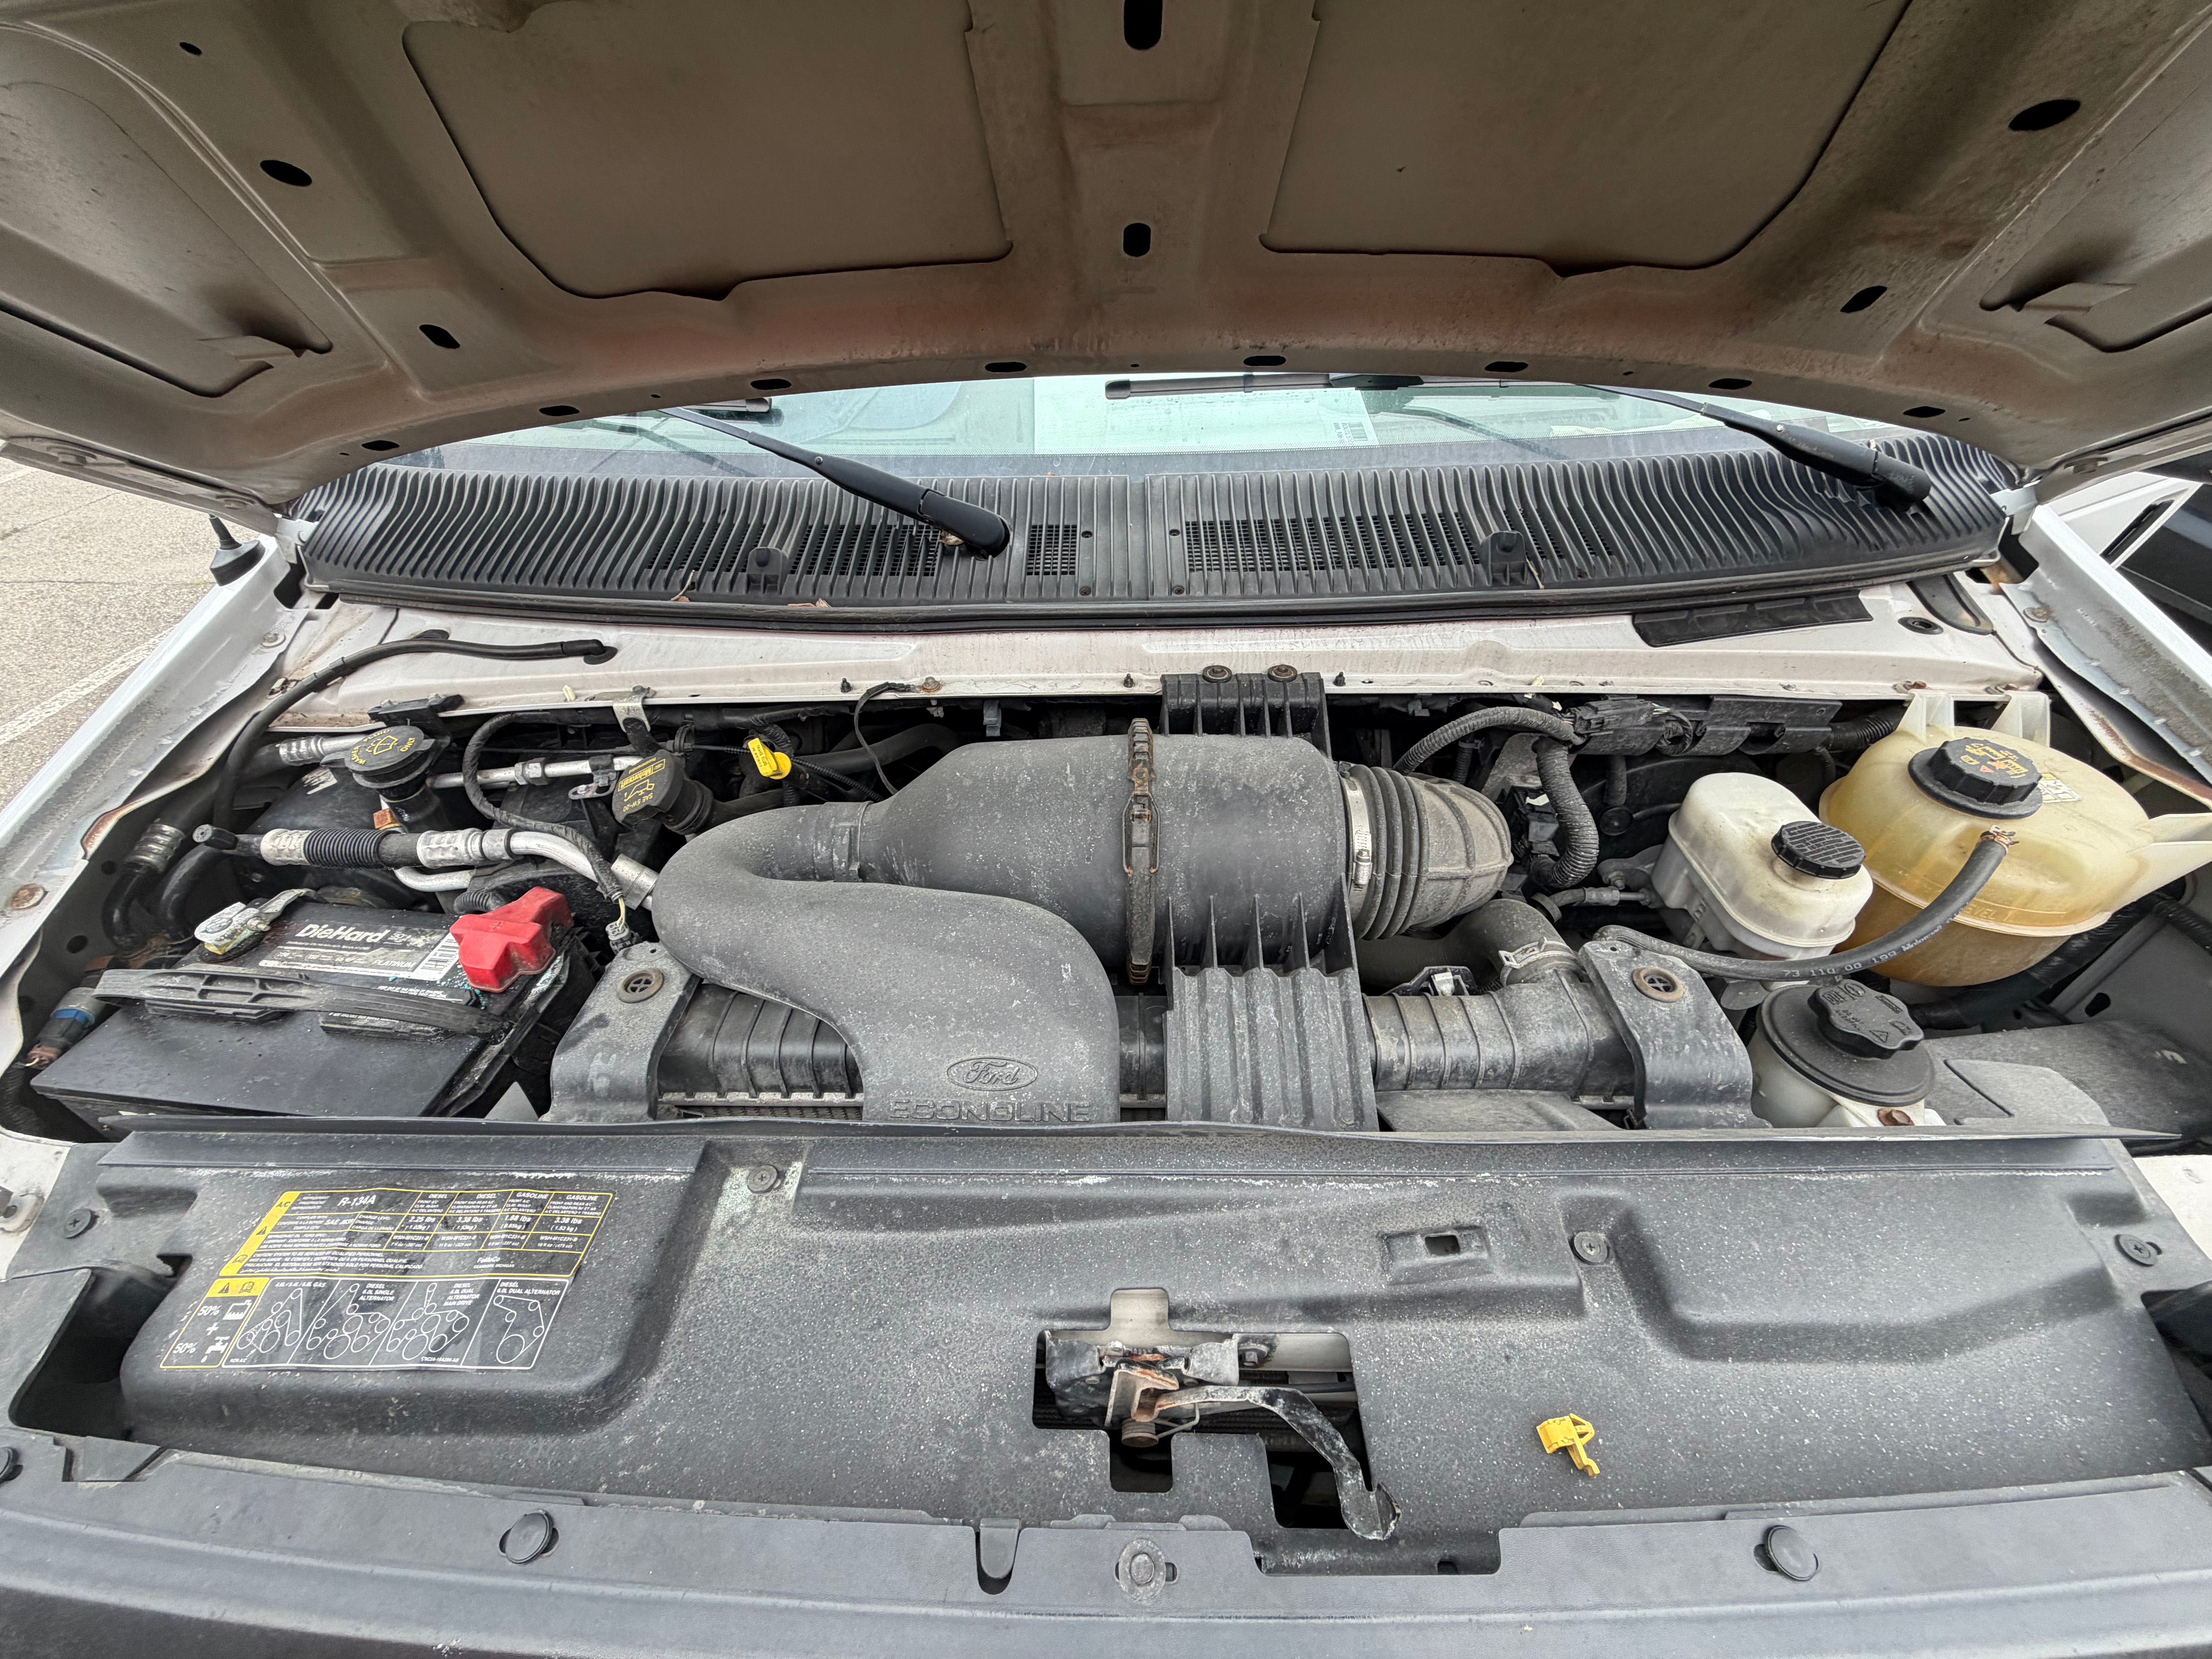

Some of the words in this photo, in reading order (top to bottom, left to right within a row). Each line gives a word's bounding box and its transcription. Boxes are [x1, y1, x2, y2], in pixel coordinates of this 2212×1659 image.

[400, 738, 415, 752] ONLY
[351, 745, 366, 765] WASHER
[620, 766, 651, 788] Motorcraft
[623, 799, 641, 812] 5W-20
[642, 793, 653, 803] SAE
[295, 924, 390, 943] DieHard
[1871, 950, 1898, 964] 199
[1901, 924, 1942, 951] Motorcraft
[963, 1061, 1020, 1084] Ford
[890, 1100, 1091, 1122] ECONOLINE
[337, 1195, 376, 1206] R-134A
[197, 1305, 222, 1316] 50%
[173, 1342, 198, 1354] 50%
